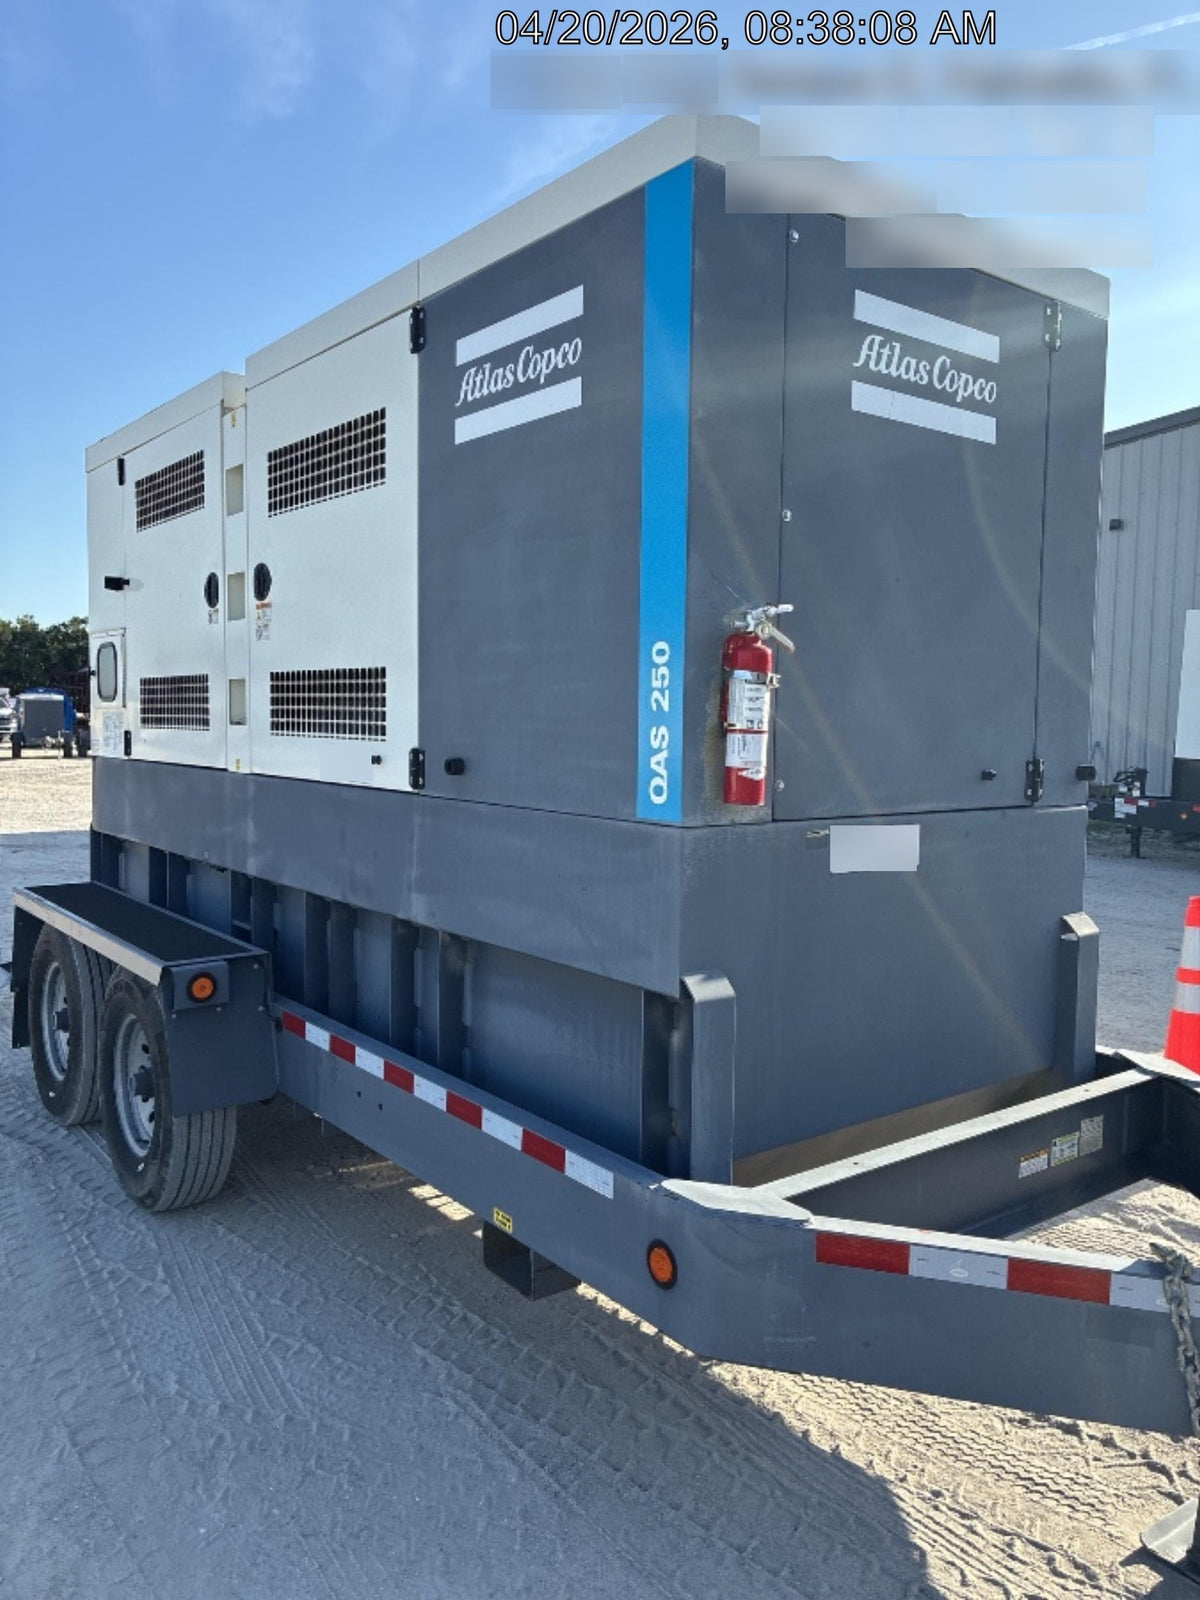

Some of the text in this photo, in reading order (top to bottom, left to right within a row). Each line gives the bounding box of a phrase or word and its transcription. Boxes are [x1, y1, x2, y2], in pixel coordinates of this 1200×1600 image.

[455, 337, 583, 407] Atlas Copco
[853, 334, 997, 404] Atlas Copco
[649, 641, 670, 805] QAS 250
